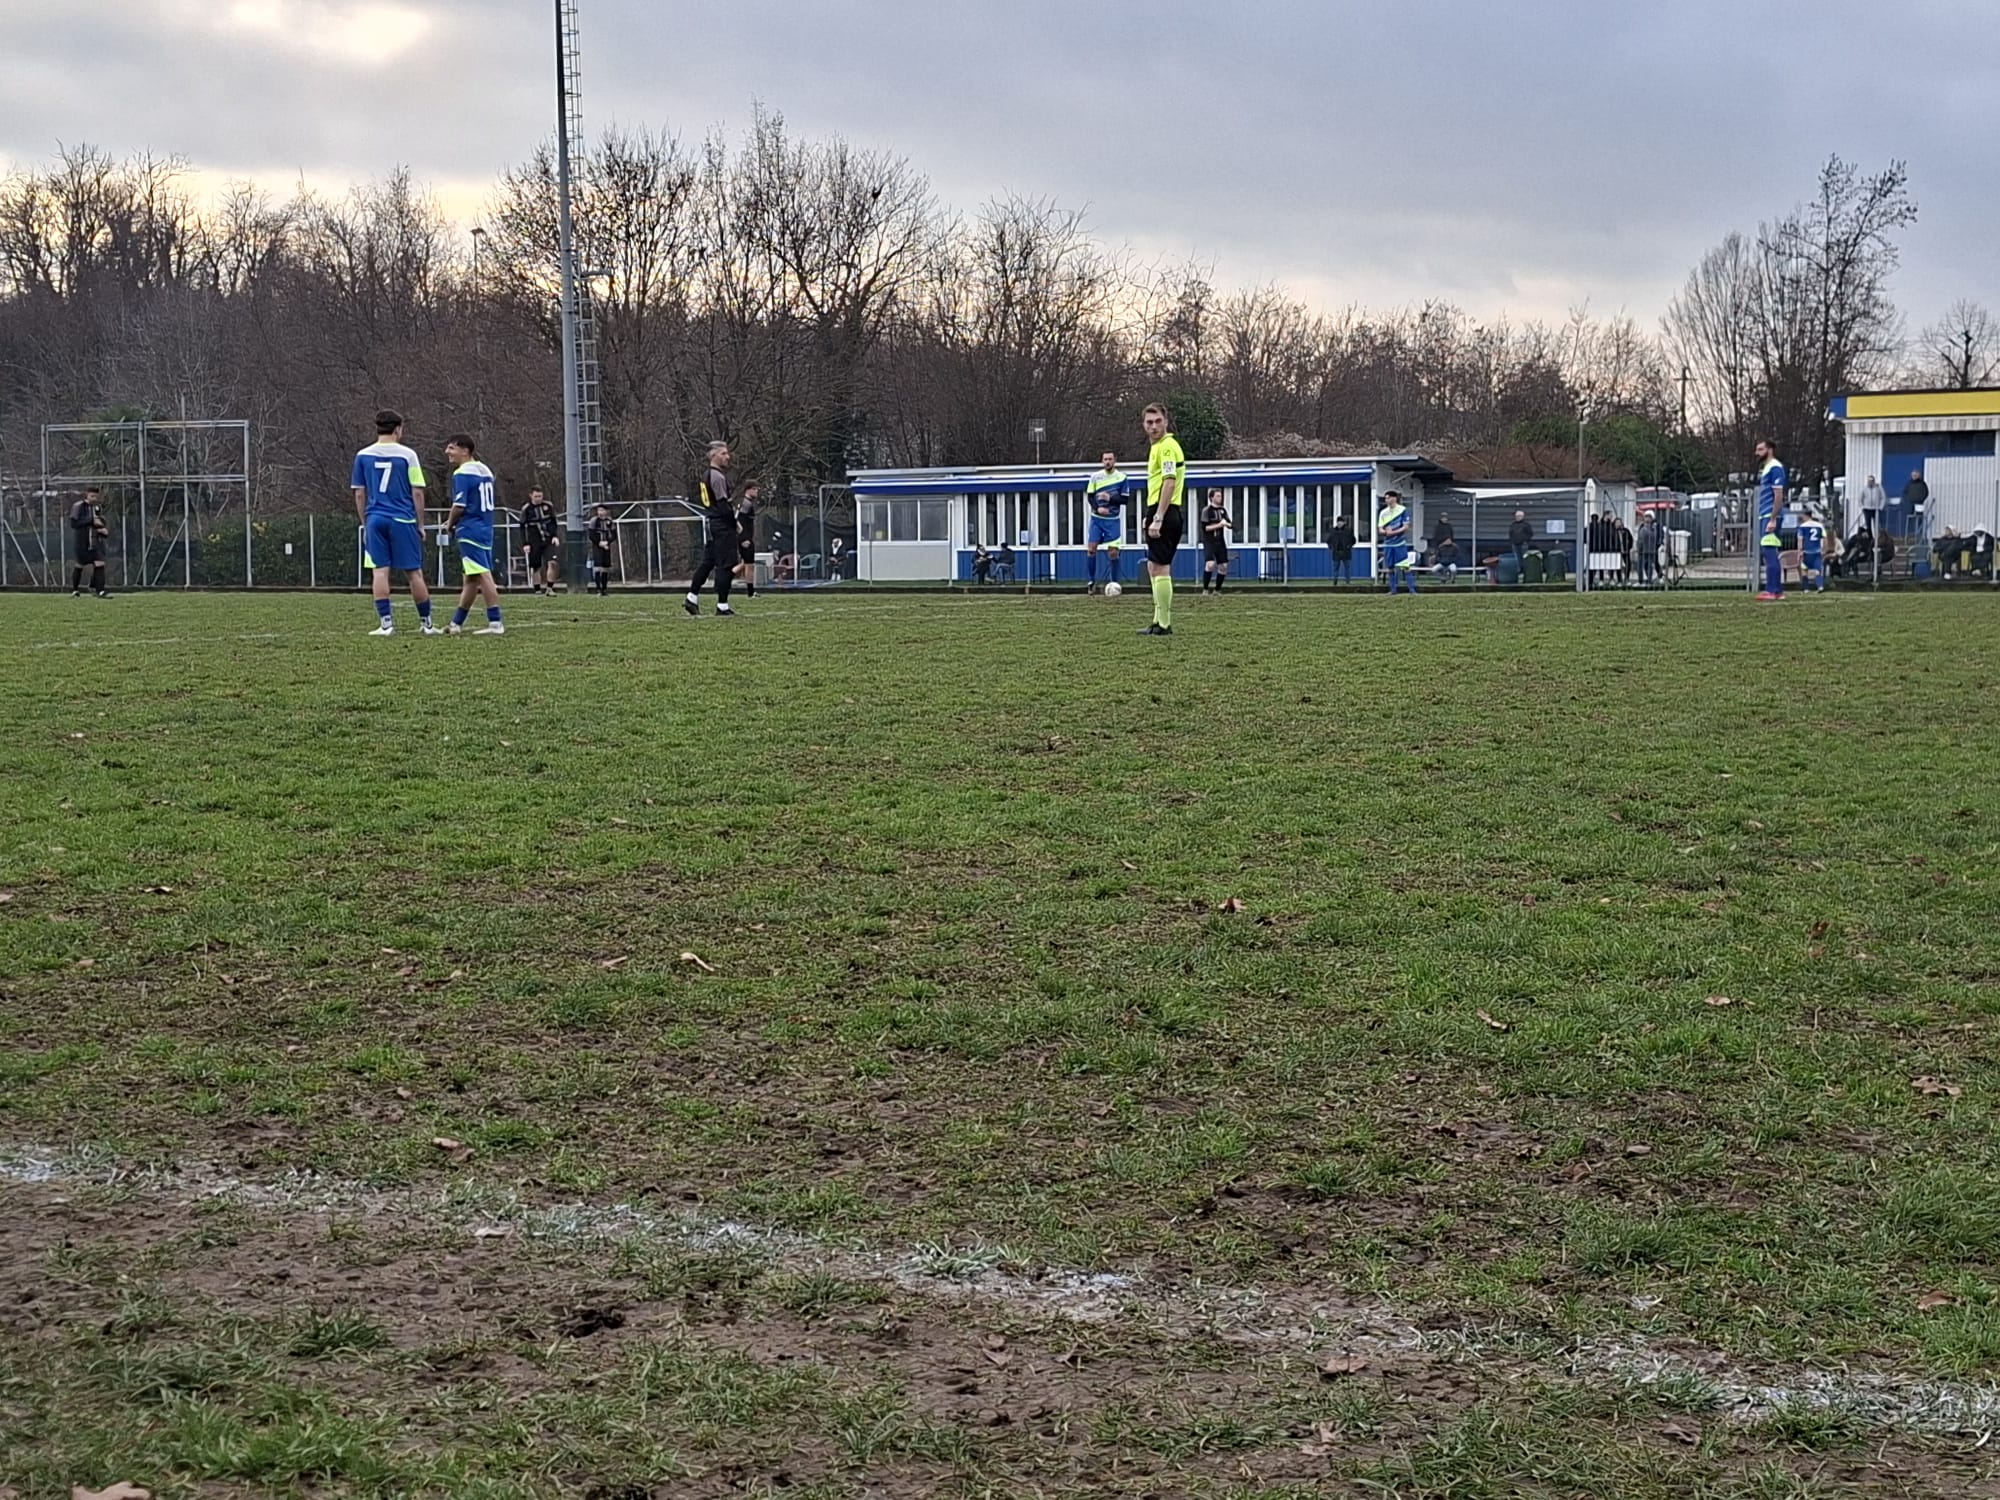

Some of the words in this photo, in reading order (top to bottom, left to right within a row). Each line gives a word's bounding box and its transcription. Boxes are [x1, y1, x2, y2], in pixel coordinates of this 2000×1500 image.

[374, 461, 392, 493] 7
[478, 481, 494, 512] 10
[1810, 528, 1818, 541] 2
